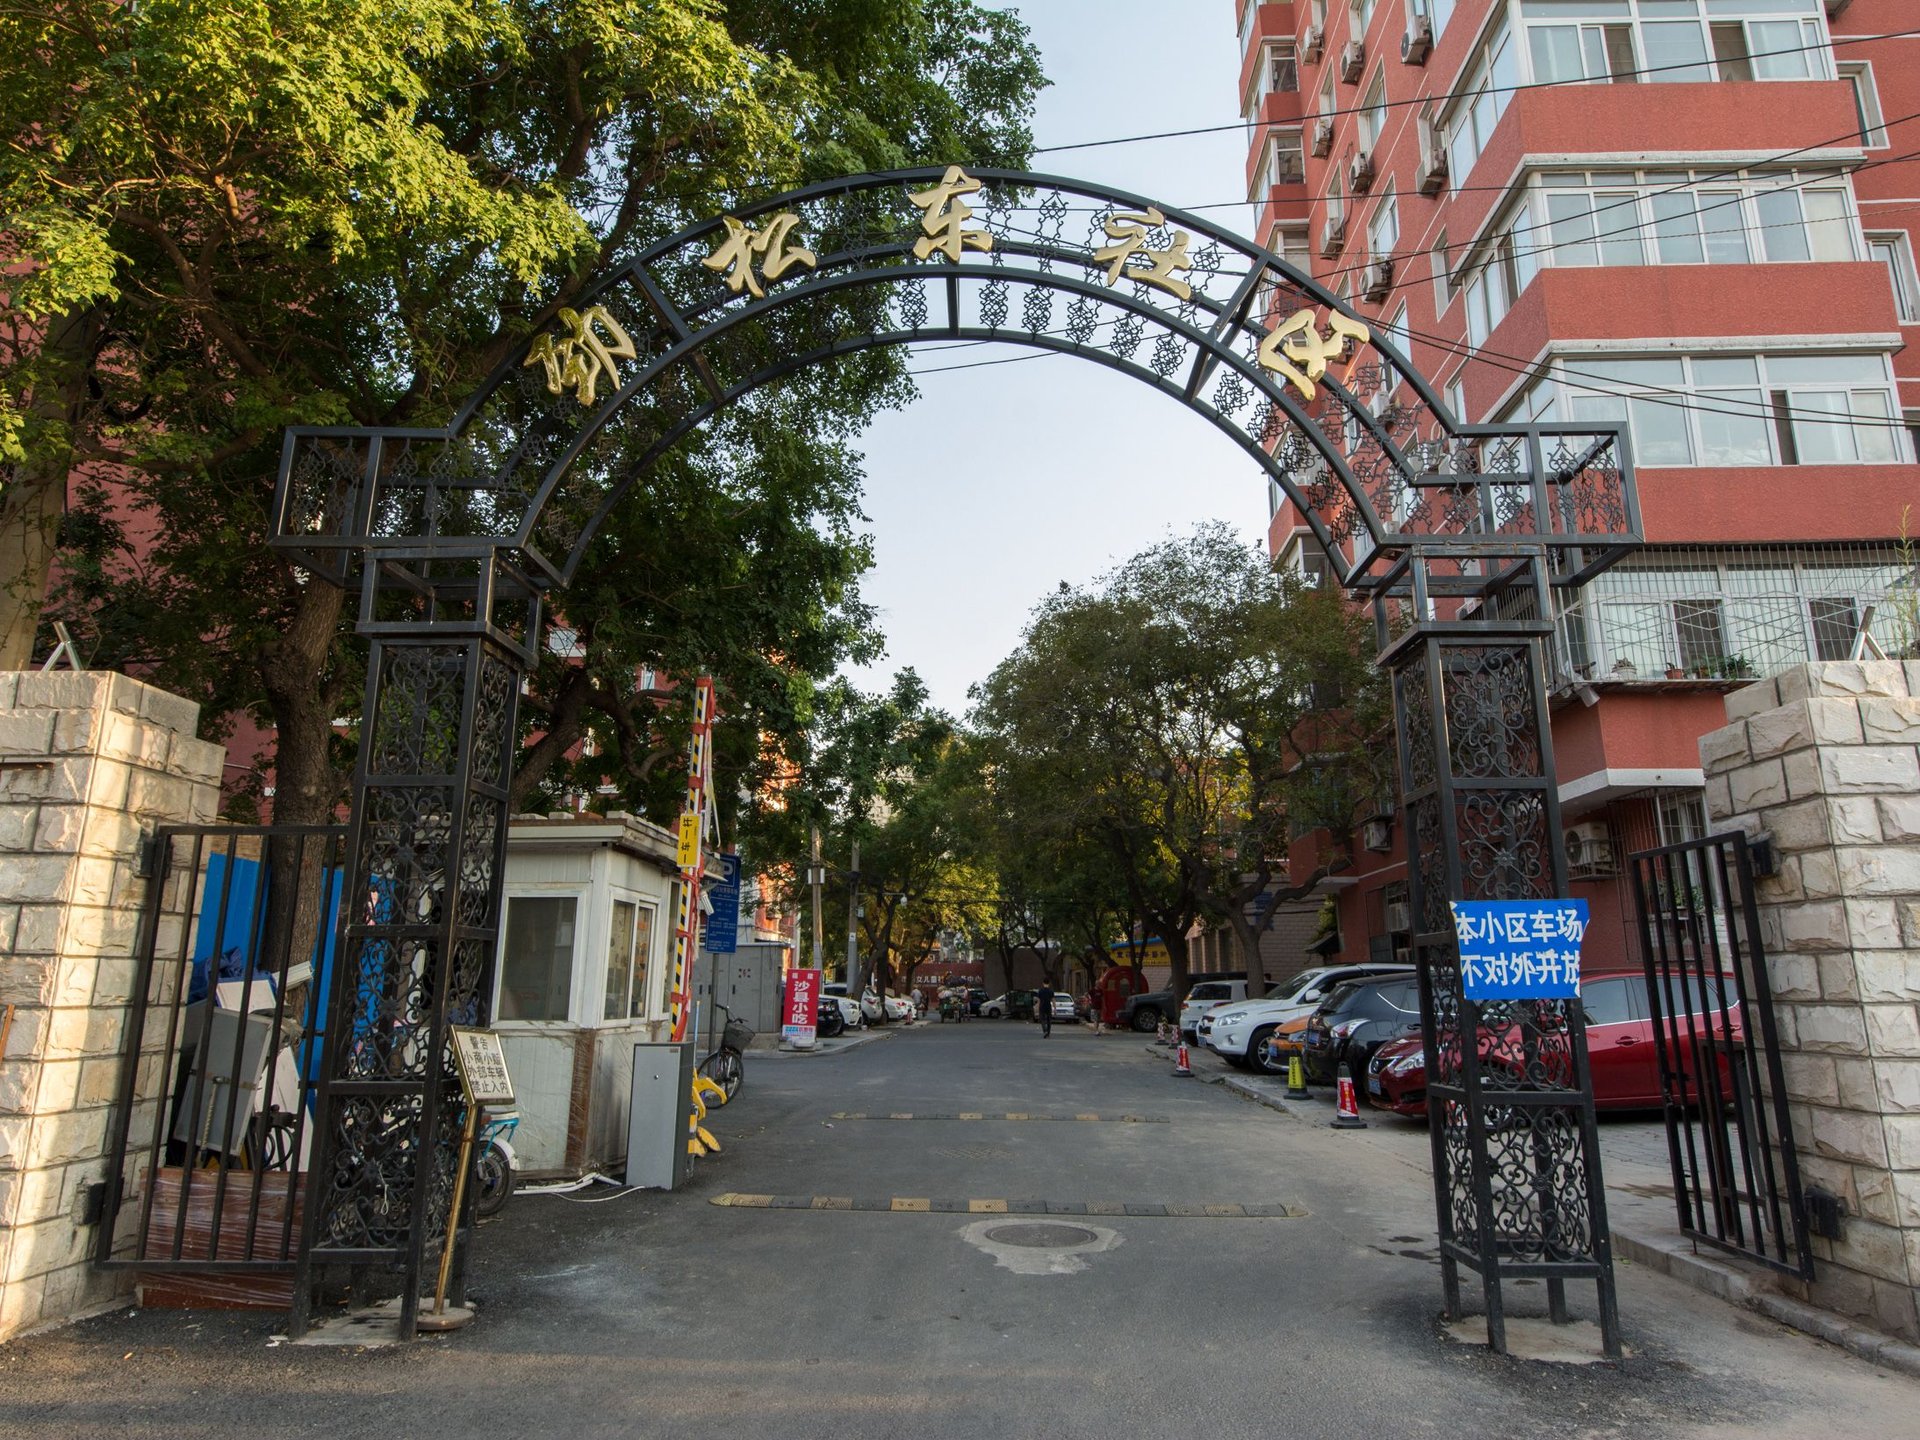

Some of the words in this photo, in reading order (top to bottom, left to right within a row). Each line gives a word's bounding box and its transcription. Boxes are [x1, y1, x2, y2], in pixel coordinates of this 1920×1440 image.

[523, 165, 1370, 406] 劲松东社区
[681, 817, 693, 864] 一车一杆
[1455, 909, 1584, 946] 本小区车场
[1460, 949, 1581, 988] 不对外开放
[792, 980, 811, 1025] 沙县小吃
[463, 1050, 501, 1066] 小商小贩
[469, 1035, 489, 1051] 警告
[467, 1065, 505, 1080] 外部车辆
[470, 1079, 509, 1095] 禁止入内
